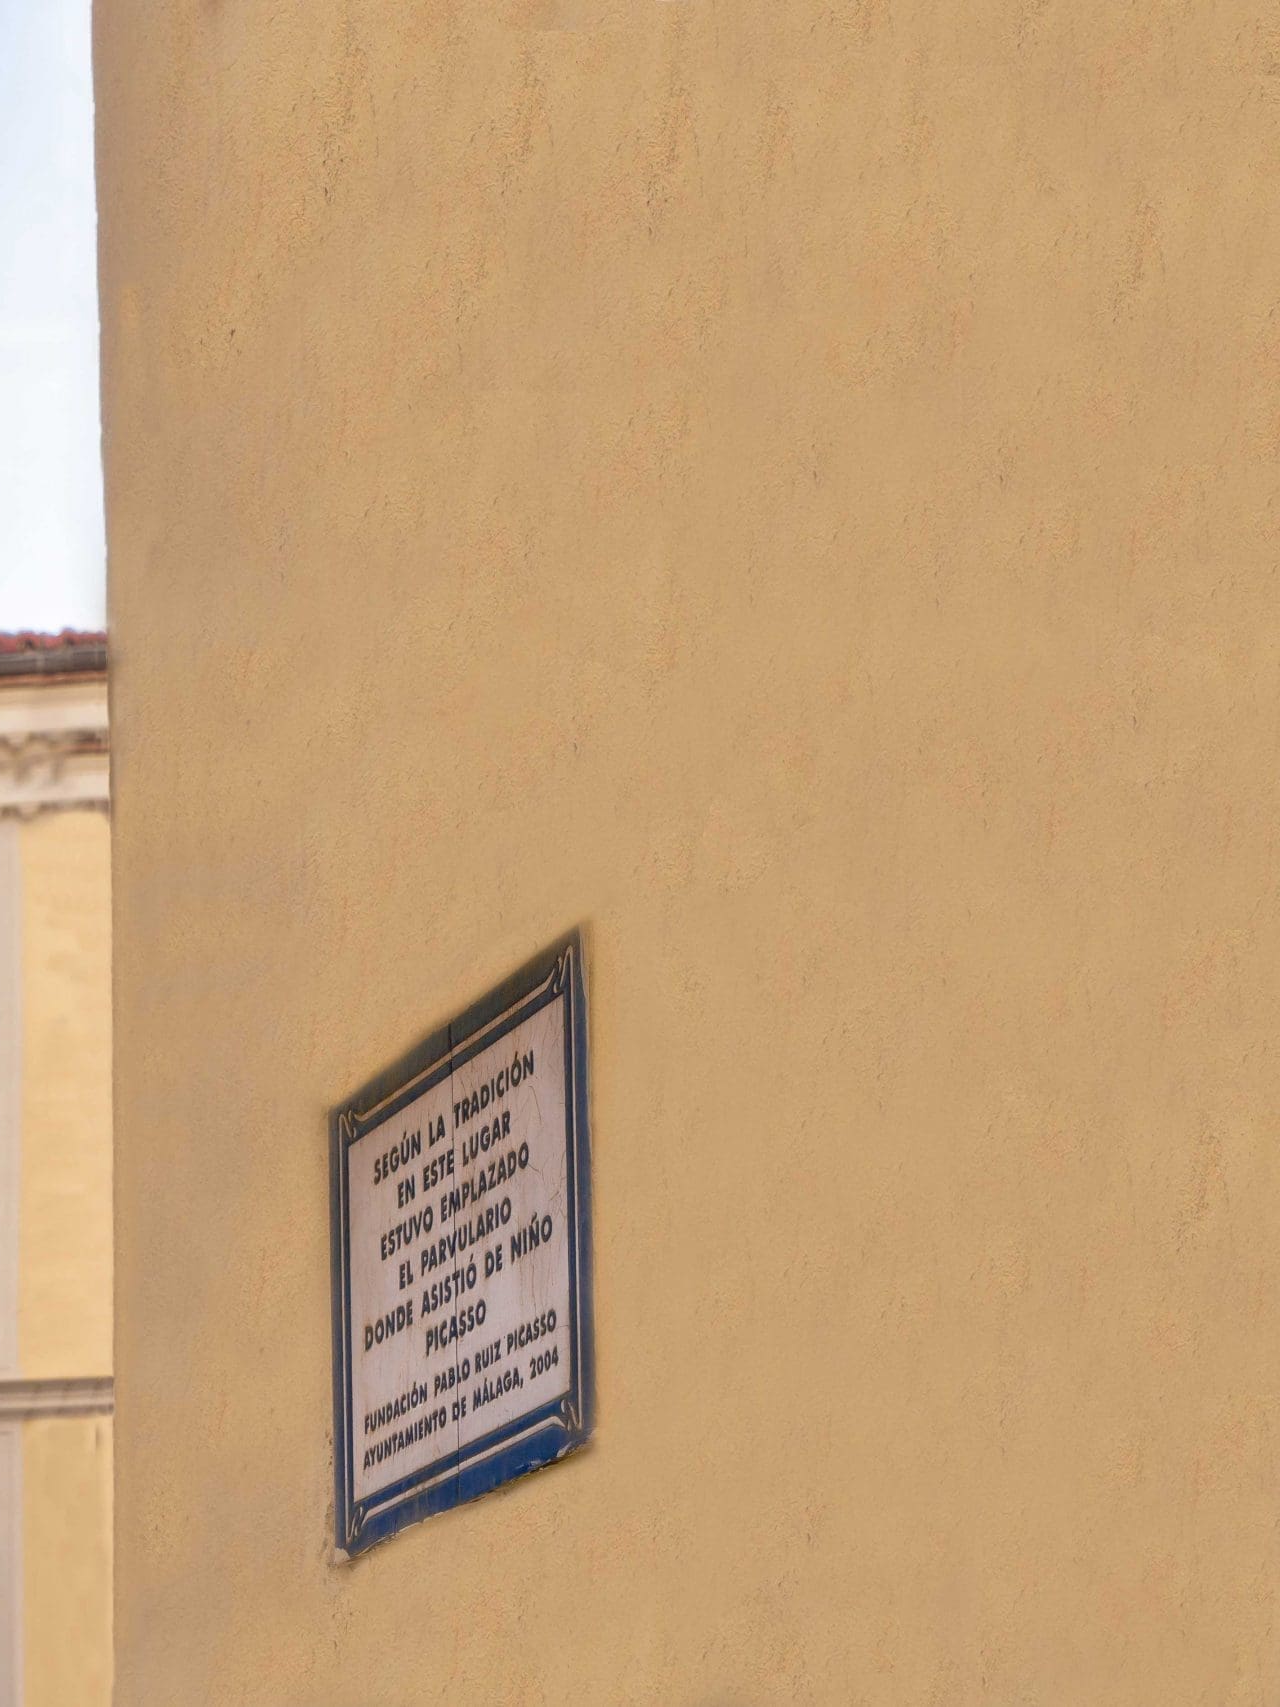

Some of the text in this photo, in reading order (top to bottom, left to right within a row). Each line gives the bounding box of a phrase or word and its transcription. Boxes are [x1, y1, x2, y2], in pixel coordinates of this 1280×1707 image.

[373, 1050, 535, 1186] SEGÚN LA TRADICIÓN
[397, 1110, 511, 1209] EN ESTE LUGAR
[380, 1141, 529, 1261] ESTUVO EMPLAZADO
[398, 1197, 512, 1290] EL PARVULARIO
[364, 1212, 553, 1352] DONDE ASISTIÓ DE NIÑO
[425, 1299, 487, 1358] PICASSO
[363, 1345, 560, 1471] AYUNTAMIENTO DE MÁLAGA, 2004
[364, 1308, 557, 1435] FUNDACIÓN PABLO RUIZ PICASSO
